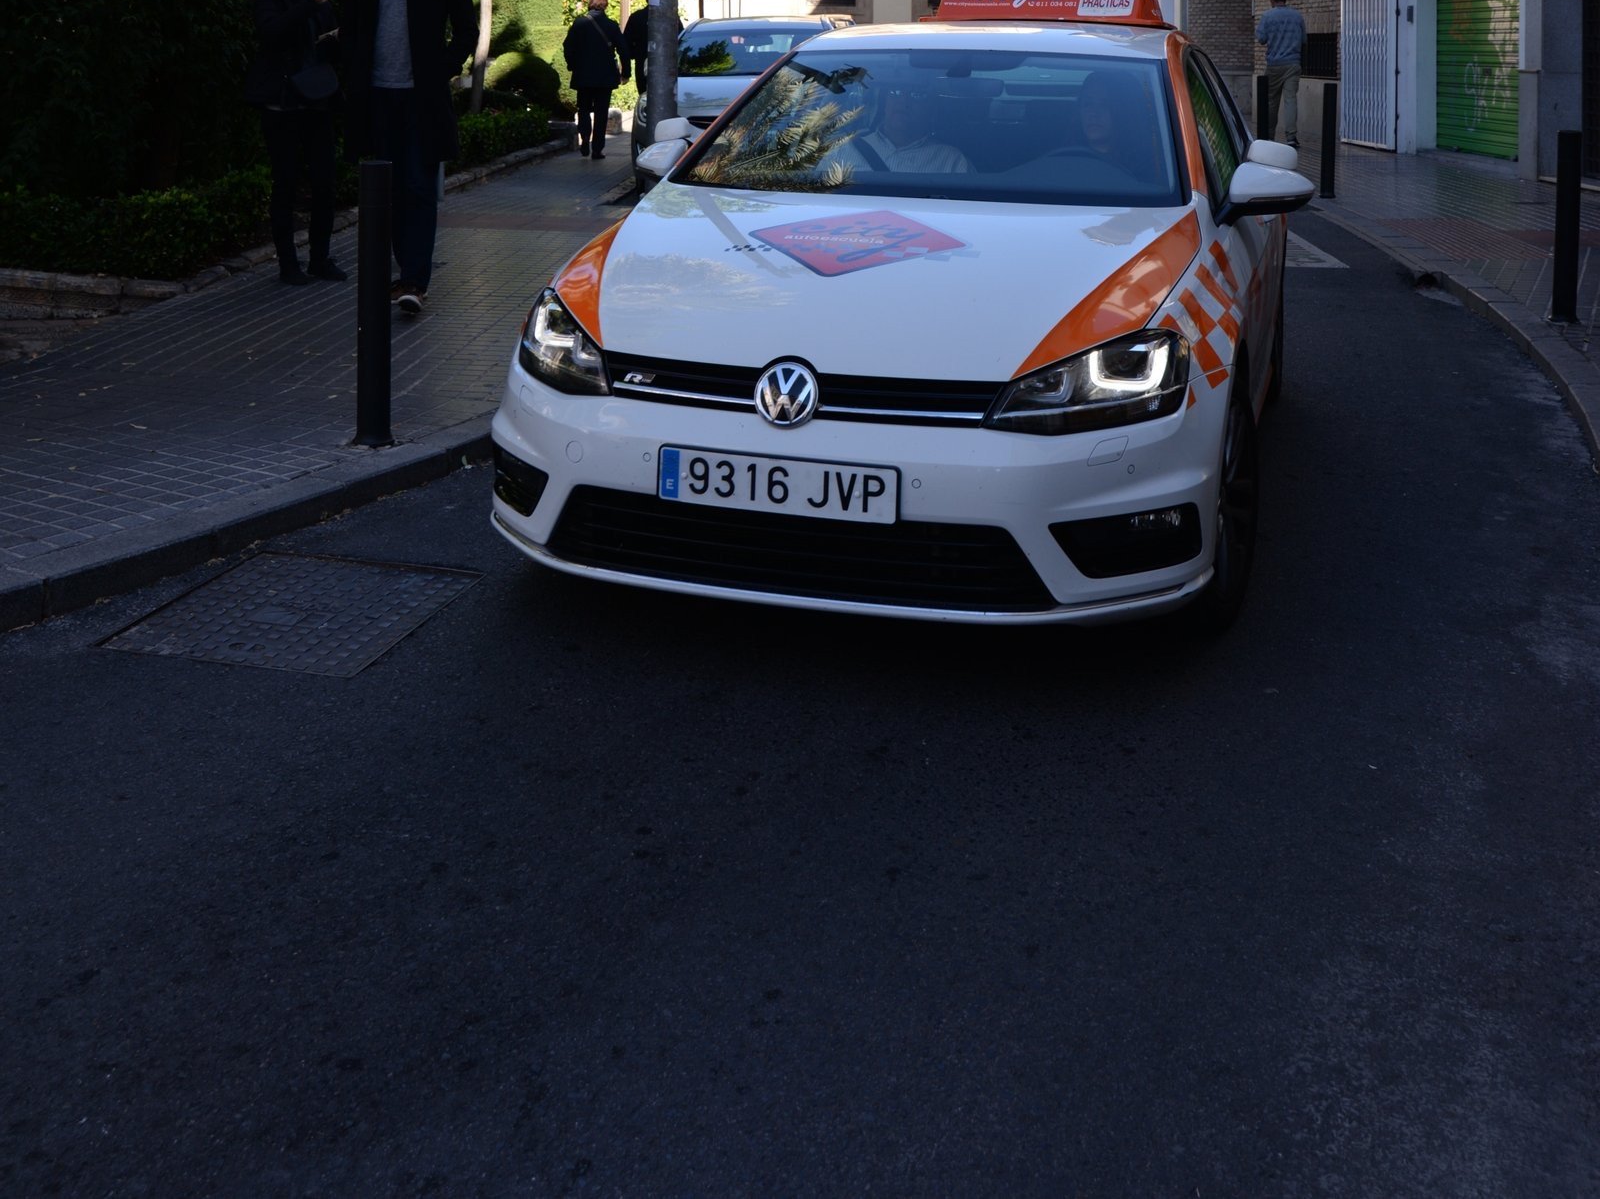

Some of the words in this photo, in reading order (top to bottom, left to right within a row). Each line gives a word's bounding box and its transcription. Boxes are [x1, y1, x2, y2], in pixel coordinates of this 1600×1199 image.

[784, 234, 885, 245] autoescuela
[791, 220, 925, 263] city
[665, 478, 675, 490] E
[688, 457, 790, 504] 9316
[807, 470, 886, 513] JVP
